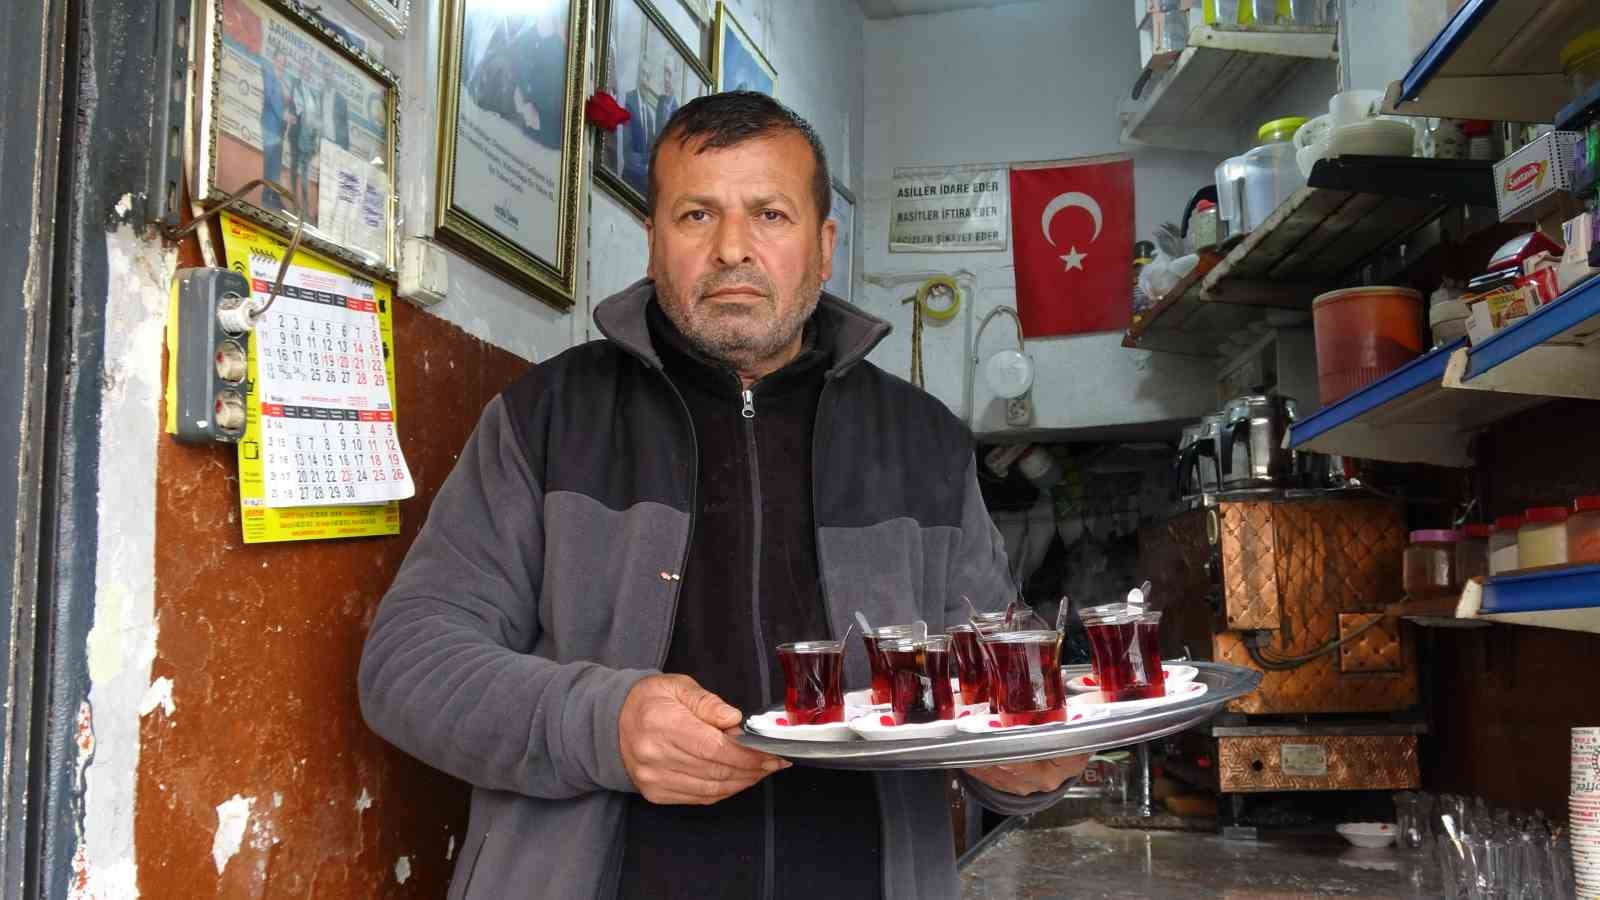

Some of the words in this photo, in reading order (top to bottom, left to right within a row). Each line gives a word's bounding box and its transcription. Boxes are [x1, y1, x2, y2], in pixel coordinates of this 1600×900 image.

[973, 182, 999, 193] EDER
[975, 231, 999, 241] EDER
[322, 338, 332, 351] 12
[338, 422, 344, 435] 2
[352, 438, 362, 451] 10
[385, 438, 396, 450] 12
[322, 454, 333, 466] 15
[354, 454, 364, 466] 17
[388, 453, 400, 465] 19
[297, 469, 308, 483] 20
[310, 469, 320, 483] 21
[325, 470, 337, 483] 22
[356, 469, 368, 482] 24
[372, 469, 386, 481] 25
[391, 468, 405, 481] 26
[299, 486, 309, 500] 27
[313, 486, 325, 499] 28
[328, 486, 341, 499] 29
